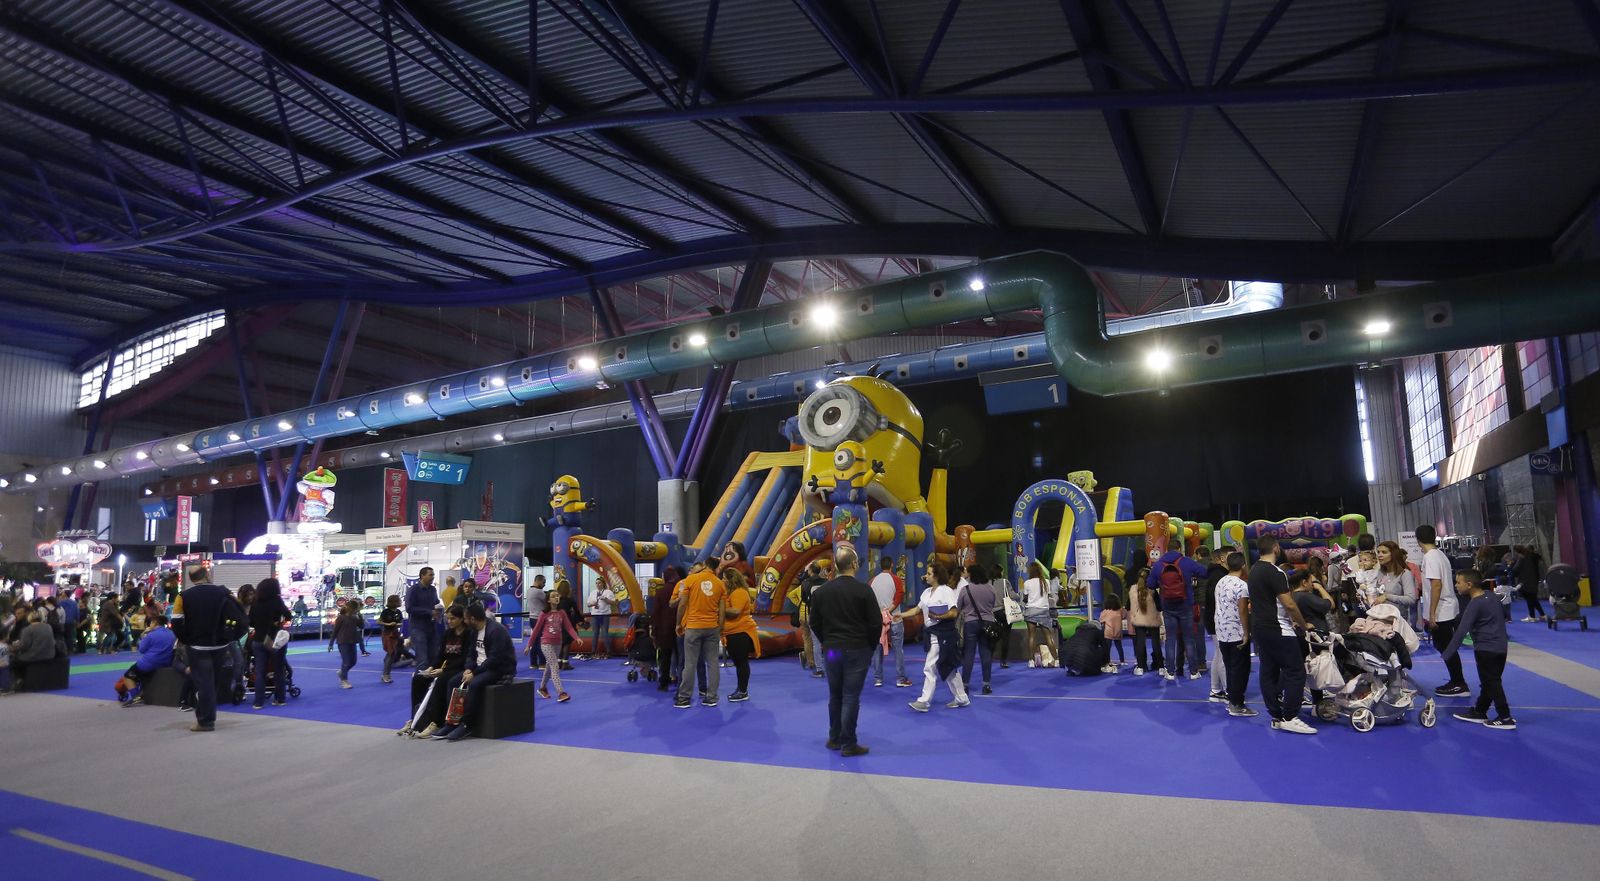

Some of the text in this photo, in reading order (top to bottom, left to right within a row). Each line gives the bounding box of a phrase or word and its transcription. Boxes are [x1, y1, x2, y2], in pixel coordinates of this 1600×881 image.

[1048, 383, 1059, 403] 1
[445, 464, 451, 472] 2
[457, 468, 464, 482] 1
[1015, 484, 1087, 518] BOB ESPONJA
[1304, 519, 1334, 538] Pig
